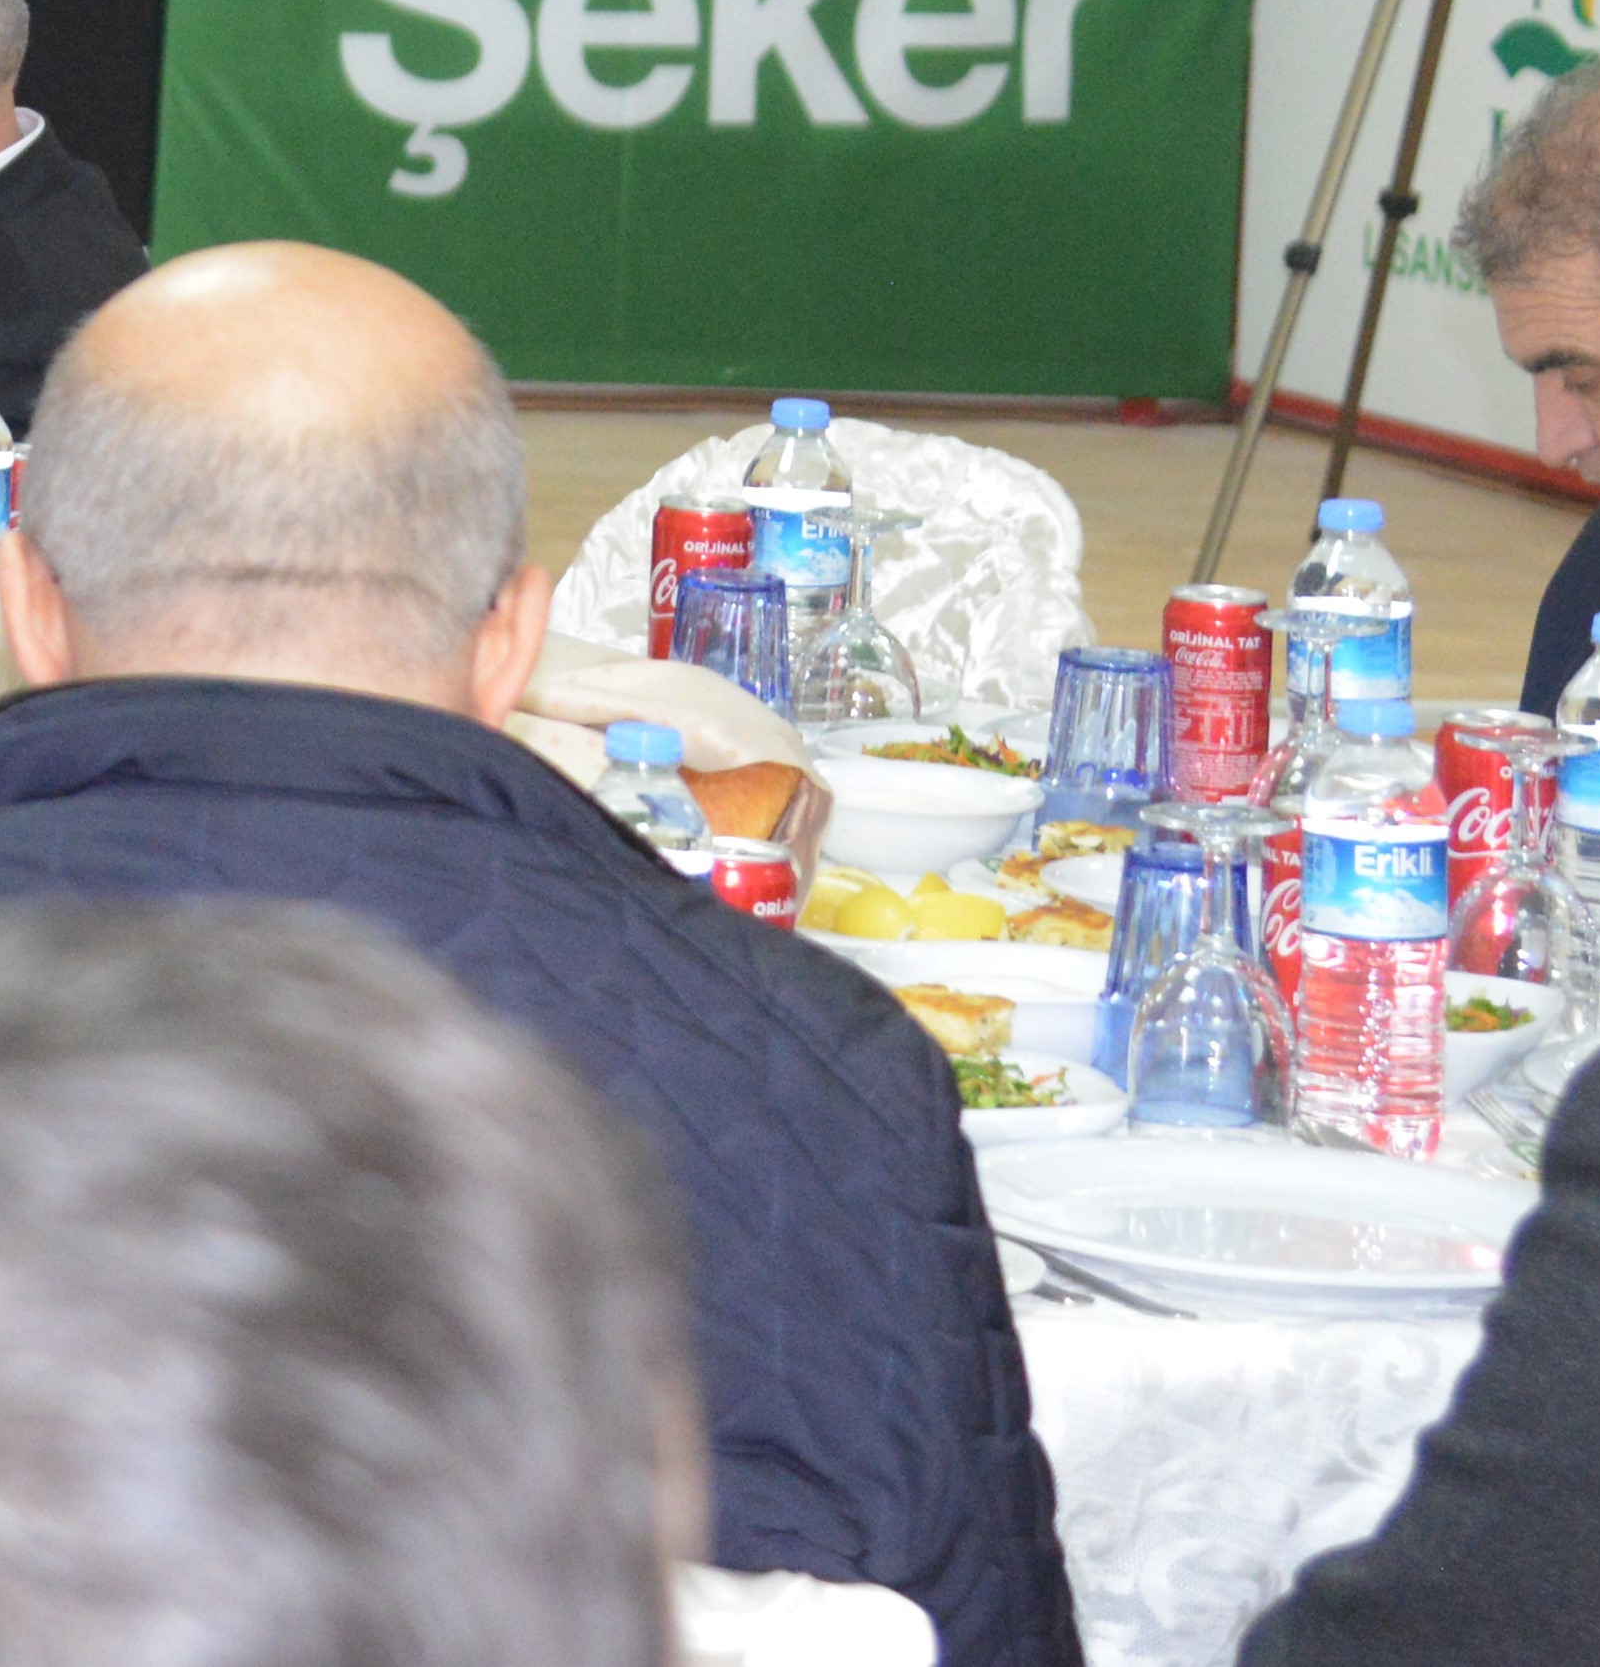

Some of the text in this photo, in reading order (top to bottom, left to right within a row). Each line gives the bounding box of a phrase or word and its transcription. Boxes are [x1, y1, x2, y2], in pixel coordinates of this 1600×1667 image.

[1169, 630, 1261, 649] ORİJİNAL TAT
[1354, 844, 1433, 878] Erikli
